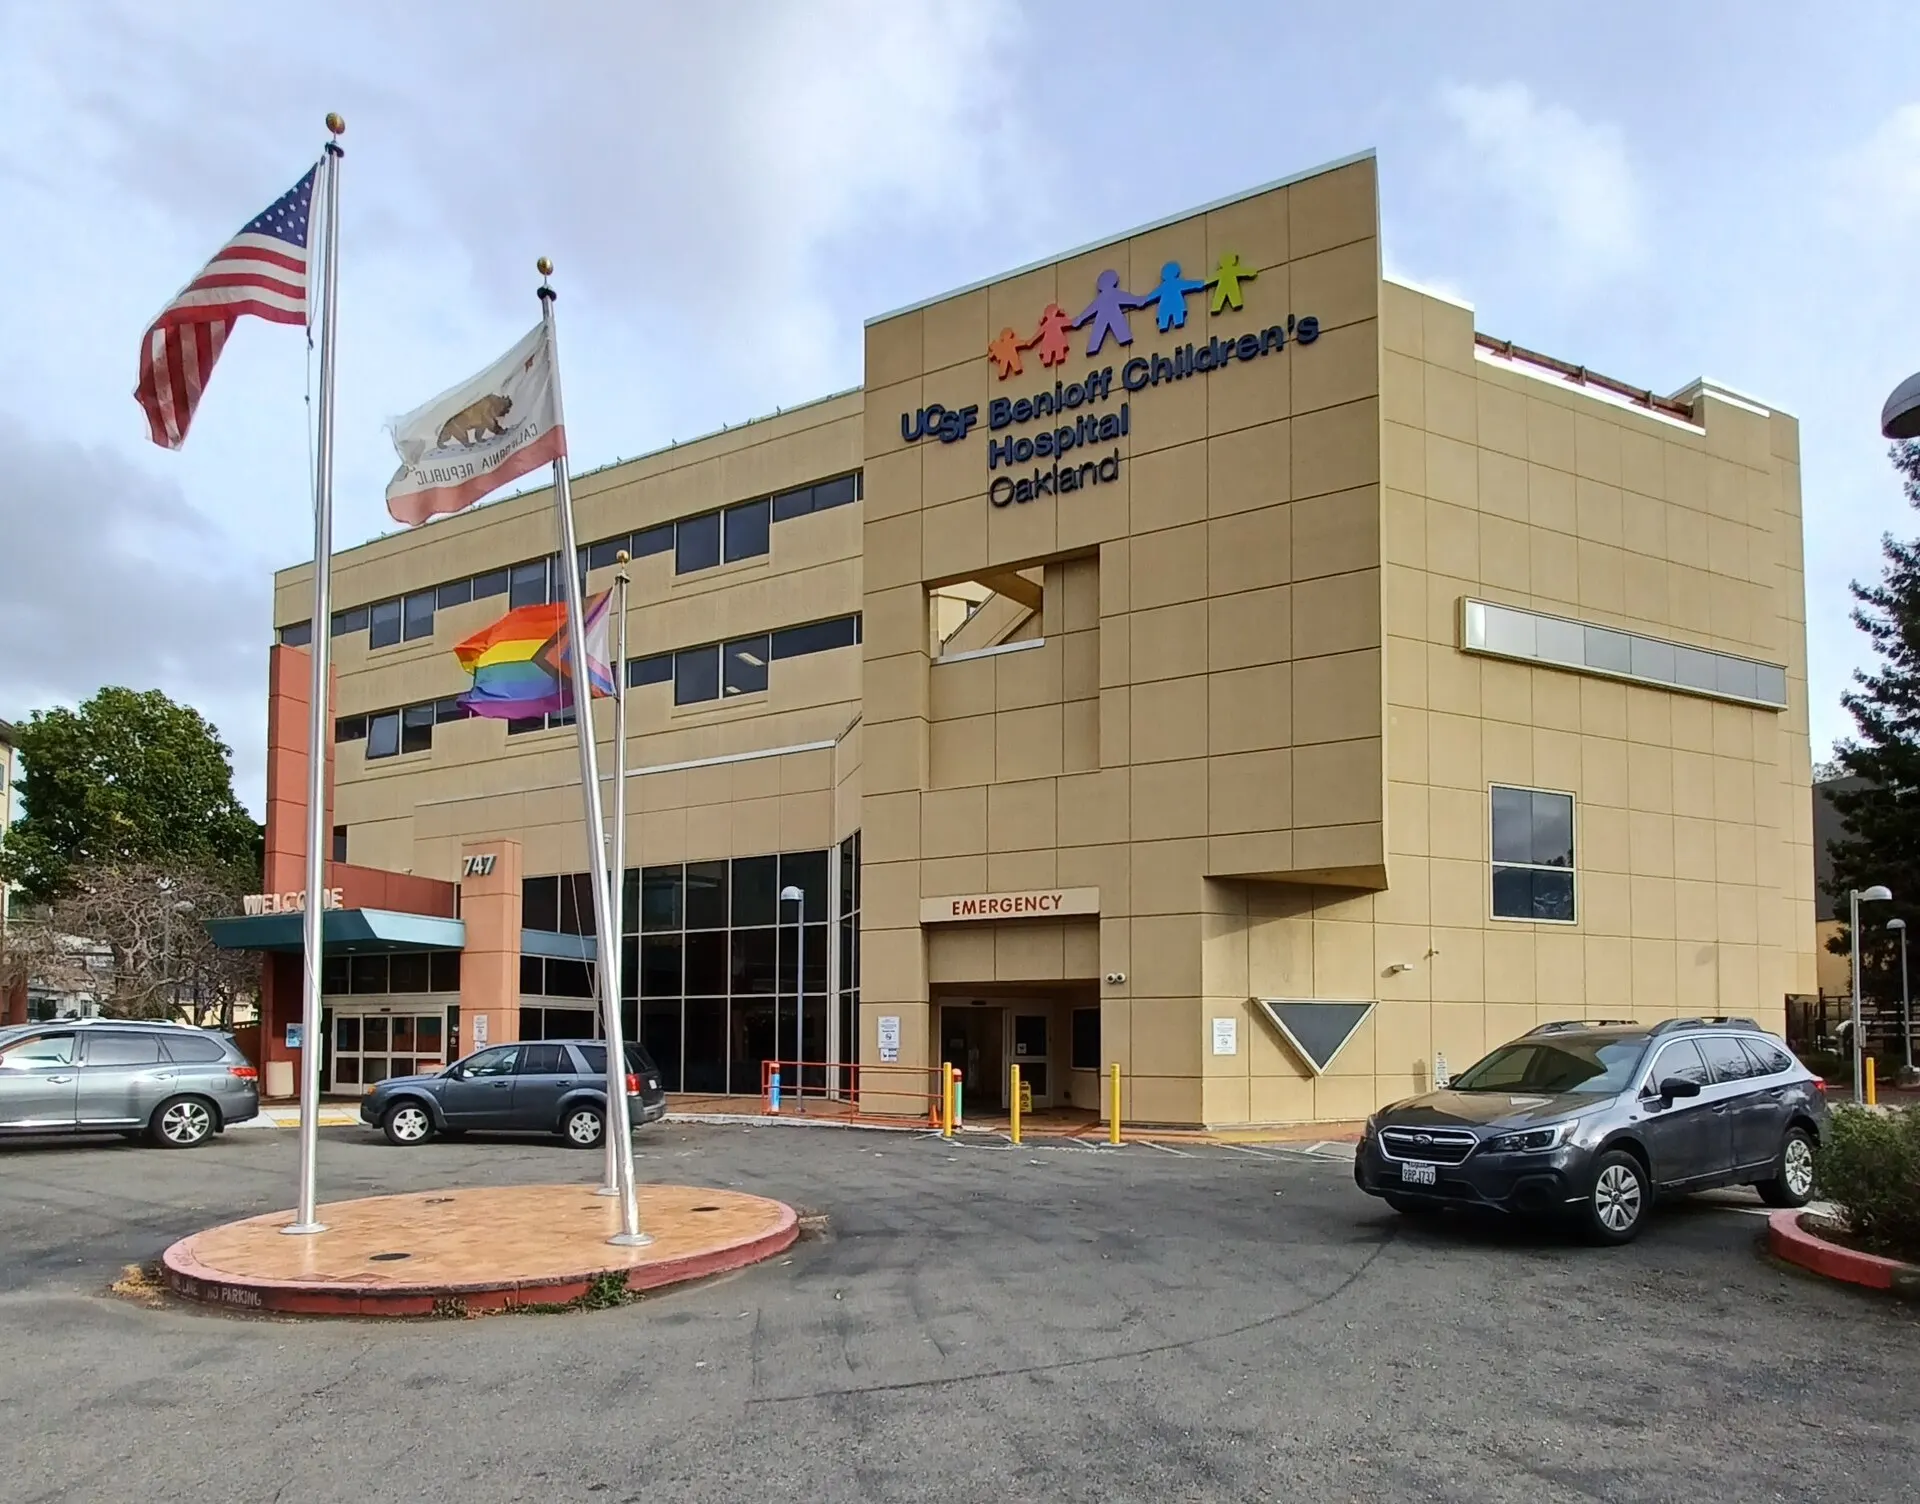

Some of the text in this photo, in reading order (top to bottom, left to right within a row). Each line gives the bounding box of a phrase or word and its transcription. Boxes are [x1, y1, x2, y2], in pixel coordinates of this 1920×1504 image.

[901, 314, 1319, 443] UCSF Benioff Children's
[989, 403, 1129, 469] Hospital
[989, 448, 1119, 507] Oakland
[463, 854, 497, 877] 747
[952, 894, 1063, 916] EMERGENCY
[222, 1287, 262, 1306] PARKING
